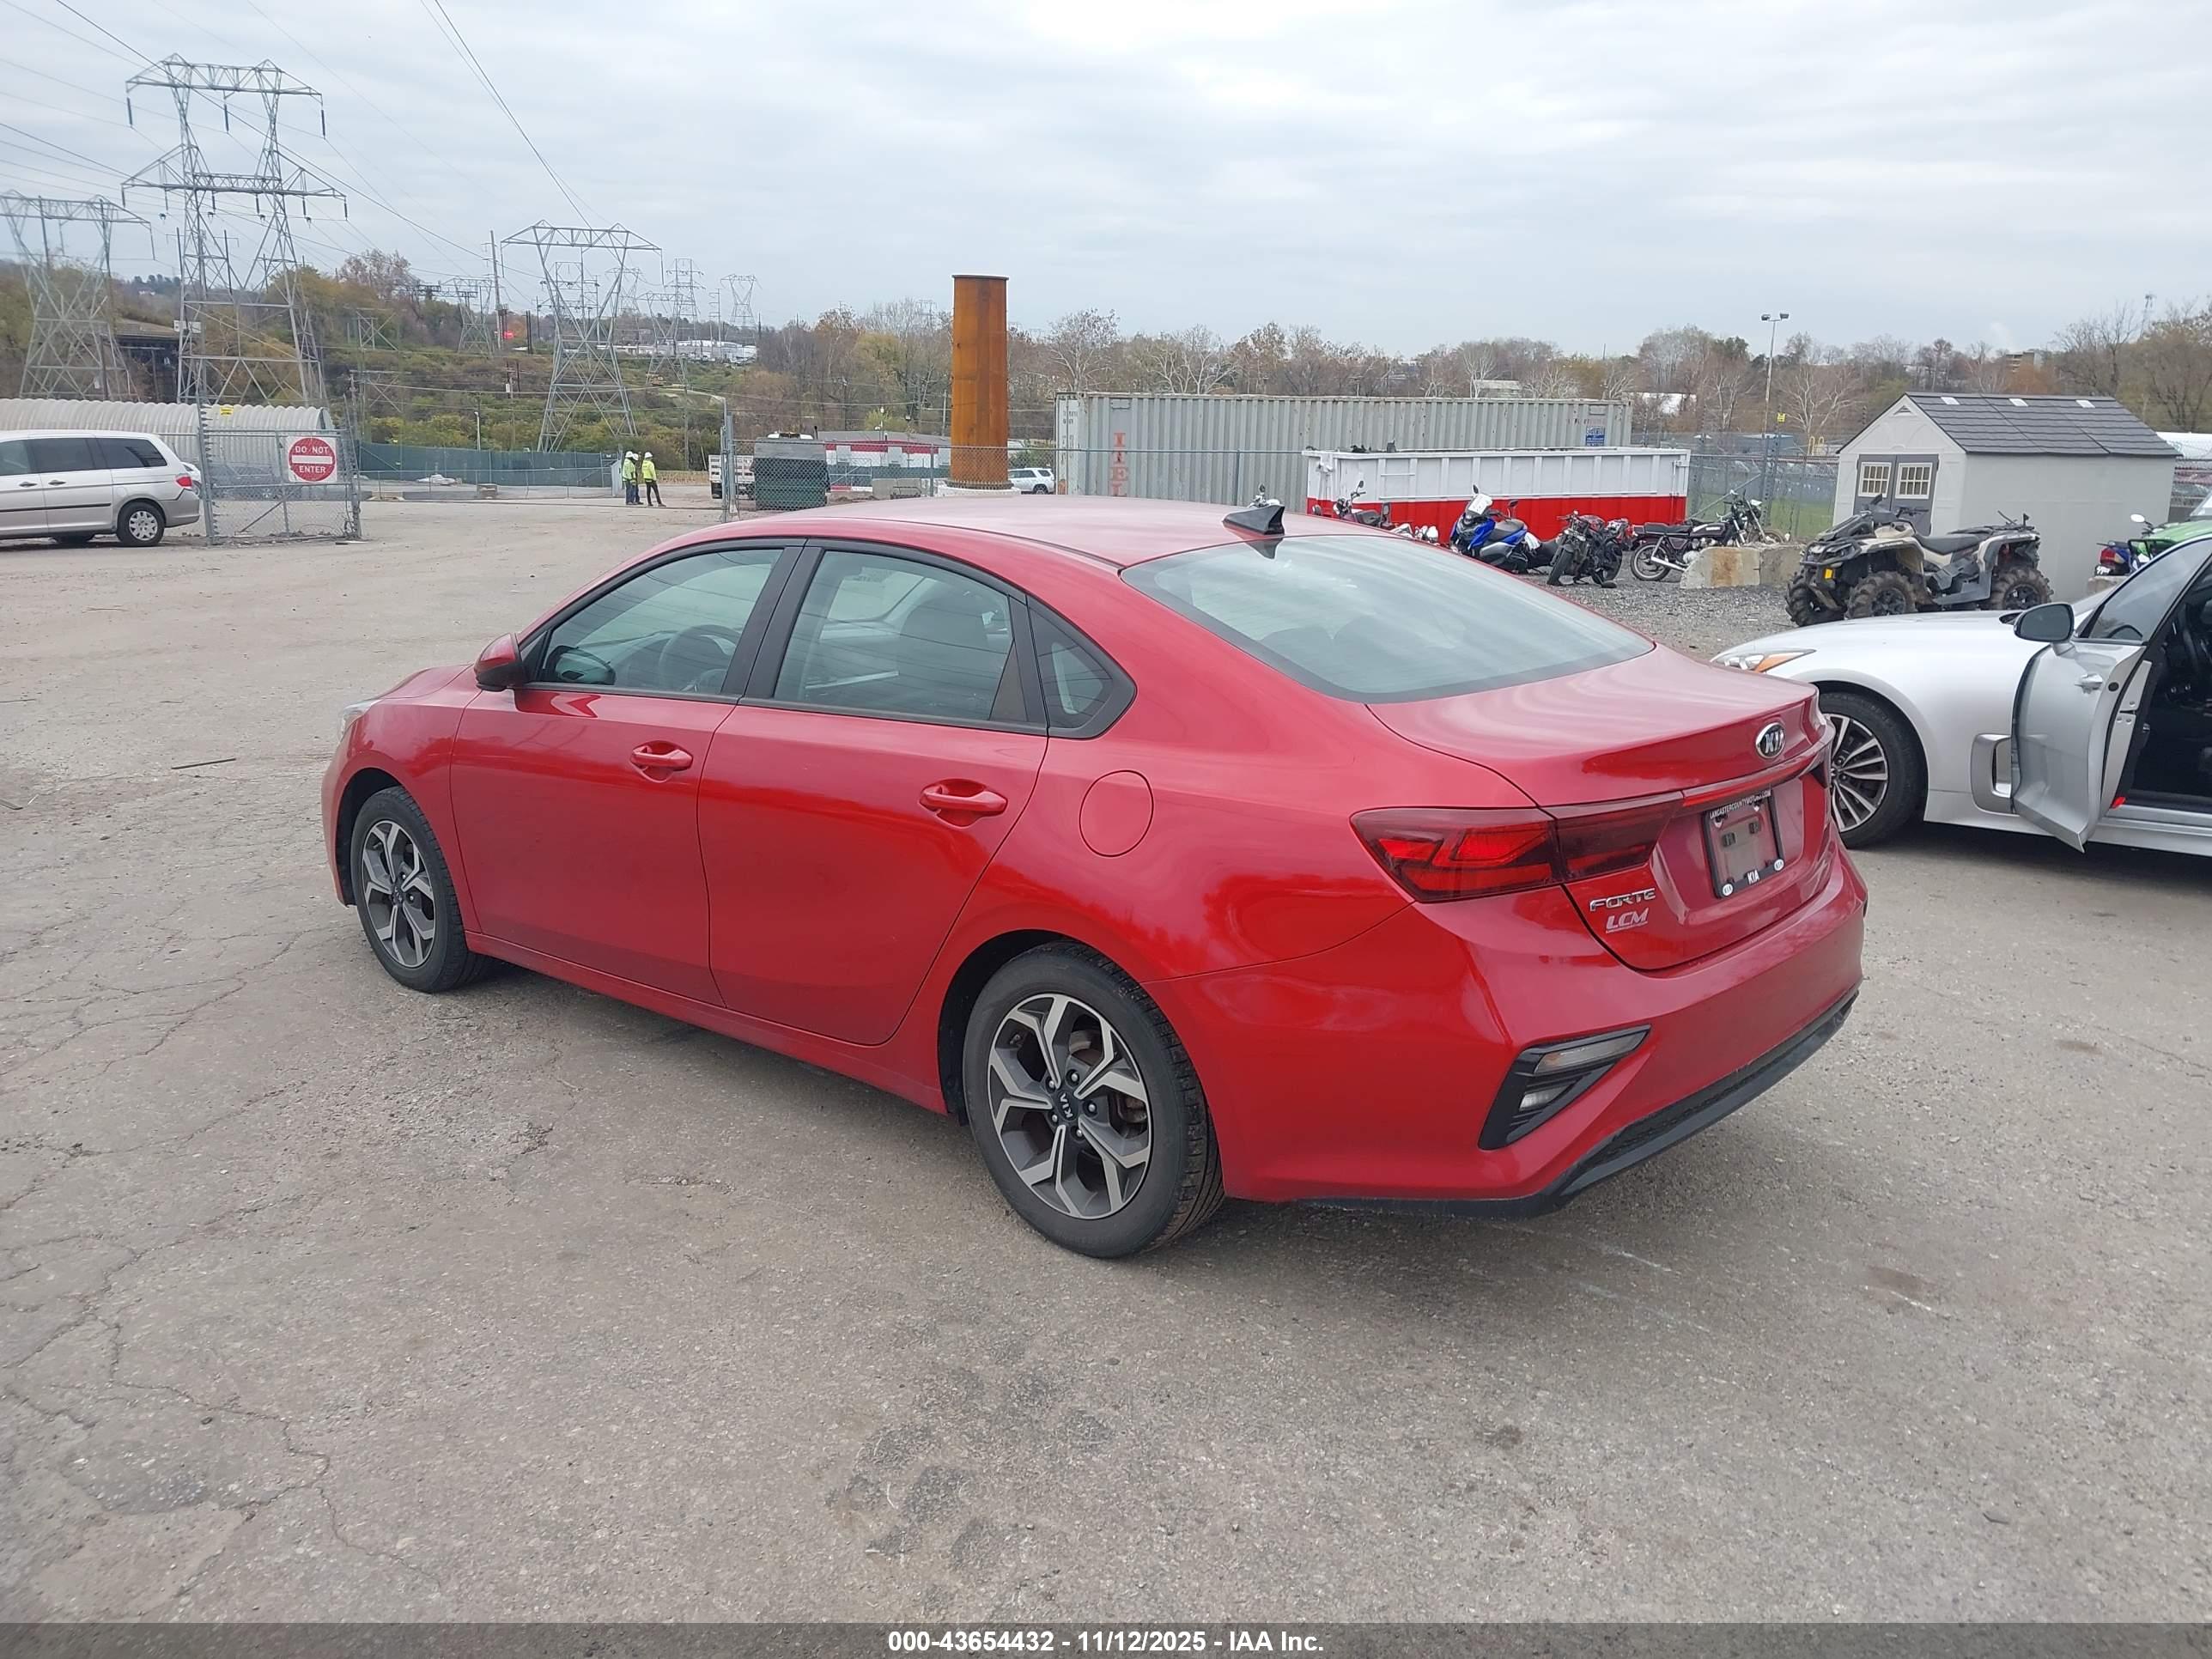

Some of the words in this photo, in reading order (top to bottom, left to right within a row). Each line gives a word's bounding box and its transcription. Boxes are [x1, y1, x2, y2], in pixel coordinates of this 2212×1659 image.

[312, 446, 329, 454] NOT
[299, 465, 326, 474] ENTER
[1765, 730, 1784, 754] KIA
[1747, 869, 1759, 884] KIA
[1590, 888, 1656, 912] FORTE
[1607, 908, 1649, 930] LCM
[1060, 1093, 1073, 1118] KIA
